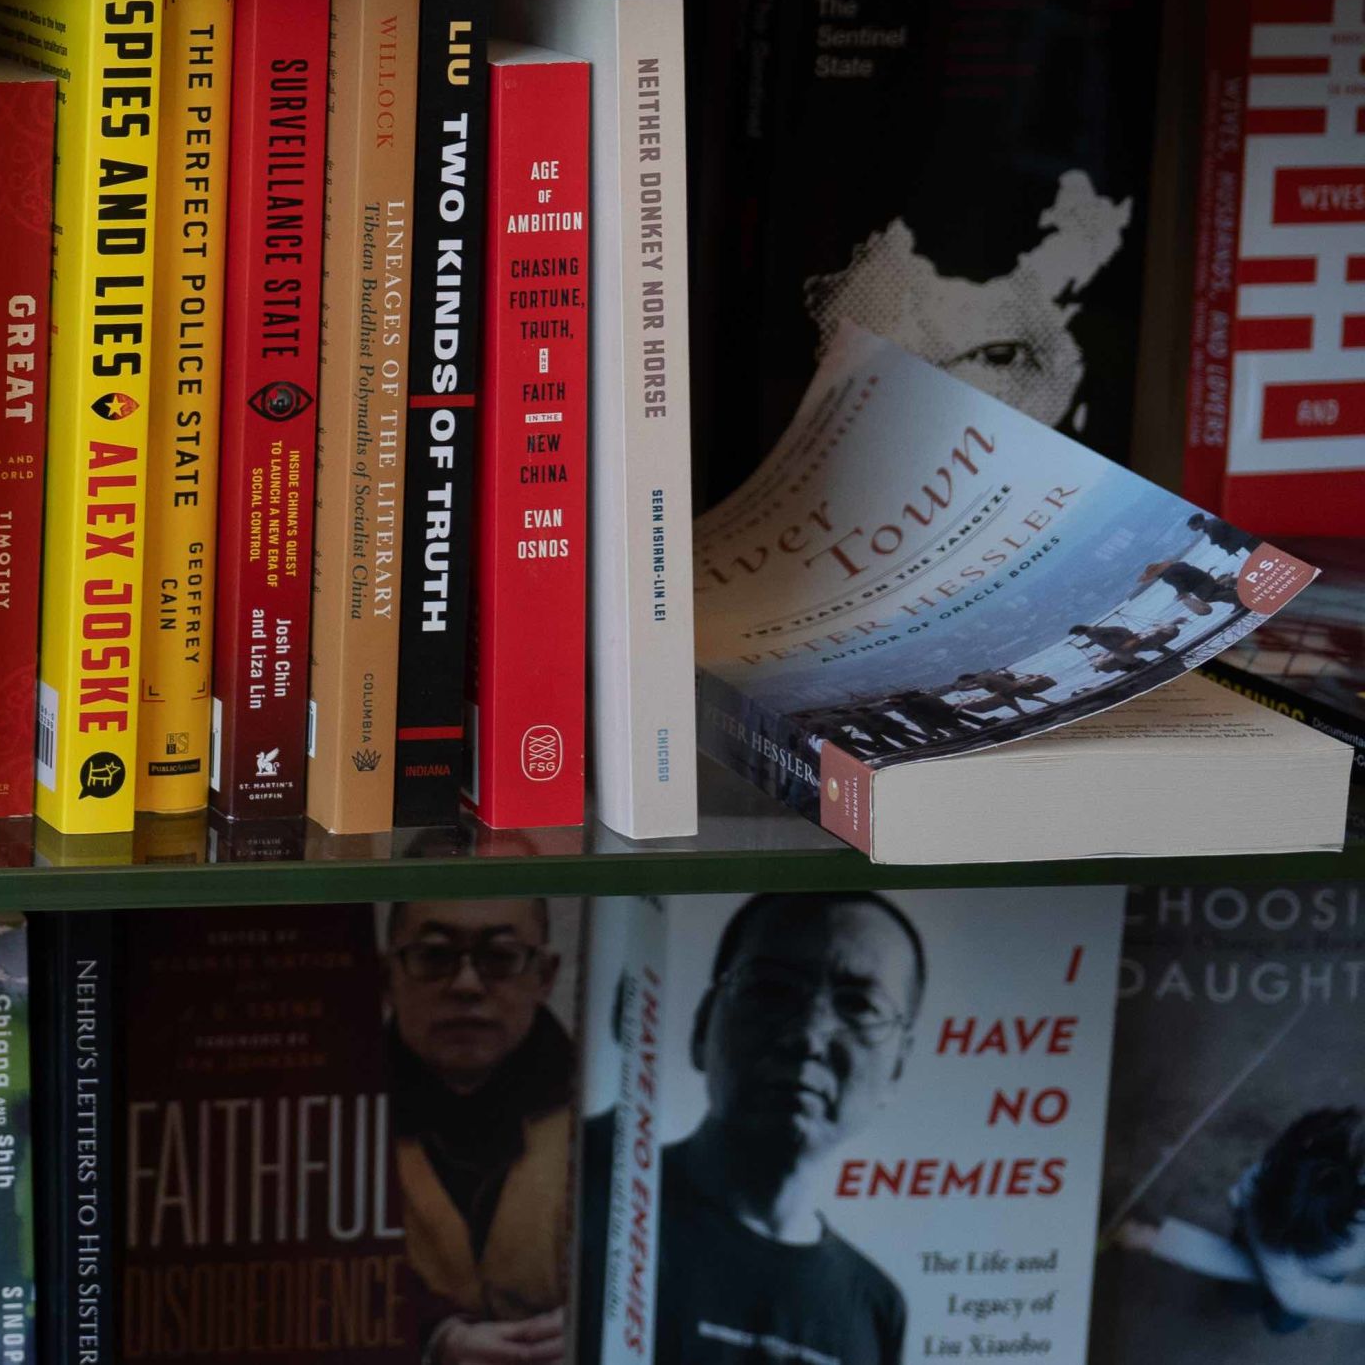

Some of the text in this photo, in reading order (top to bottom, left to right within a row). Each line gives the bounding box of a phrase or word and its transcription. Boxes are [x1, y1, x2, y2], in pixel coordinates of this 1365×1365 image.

[447, 21, 472, 86] LIU
[92, 0, 155, 378] SPIES AND LIES
[531, 161, 559, 180] AGE
[538, 189, 552, 204] OF
[260, 59, 309, 360] SURVEILLANCE STATE
[507, 212, 583, 233] AMBITION
[637, 58, 666, 419] NEITHER DONKEY NOR HORSE
[421, 112, 468, 633] TWO KINDS OF TRUTH
[802, 426, 996, 581] Town
[79, 441, 138, 734] ALEX JOSKE
[740, 480, 1081, 668] PETER HESSLER
[1064, 945, 1083, 984] I
[936, 1016, 1077, 1056] HAVE
[988, 1088, 1070, 1126] NO
[835, 1159, 1066, 1198] ENEMIES
